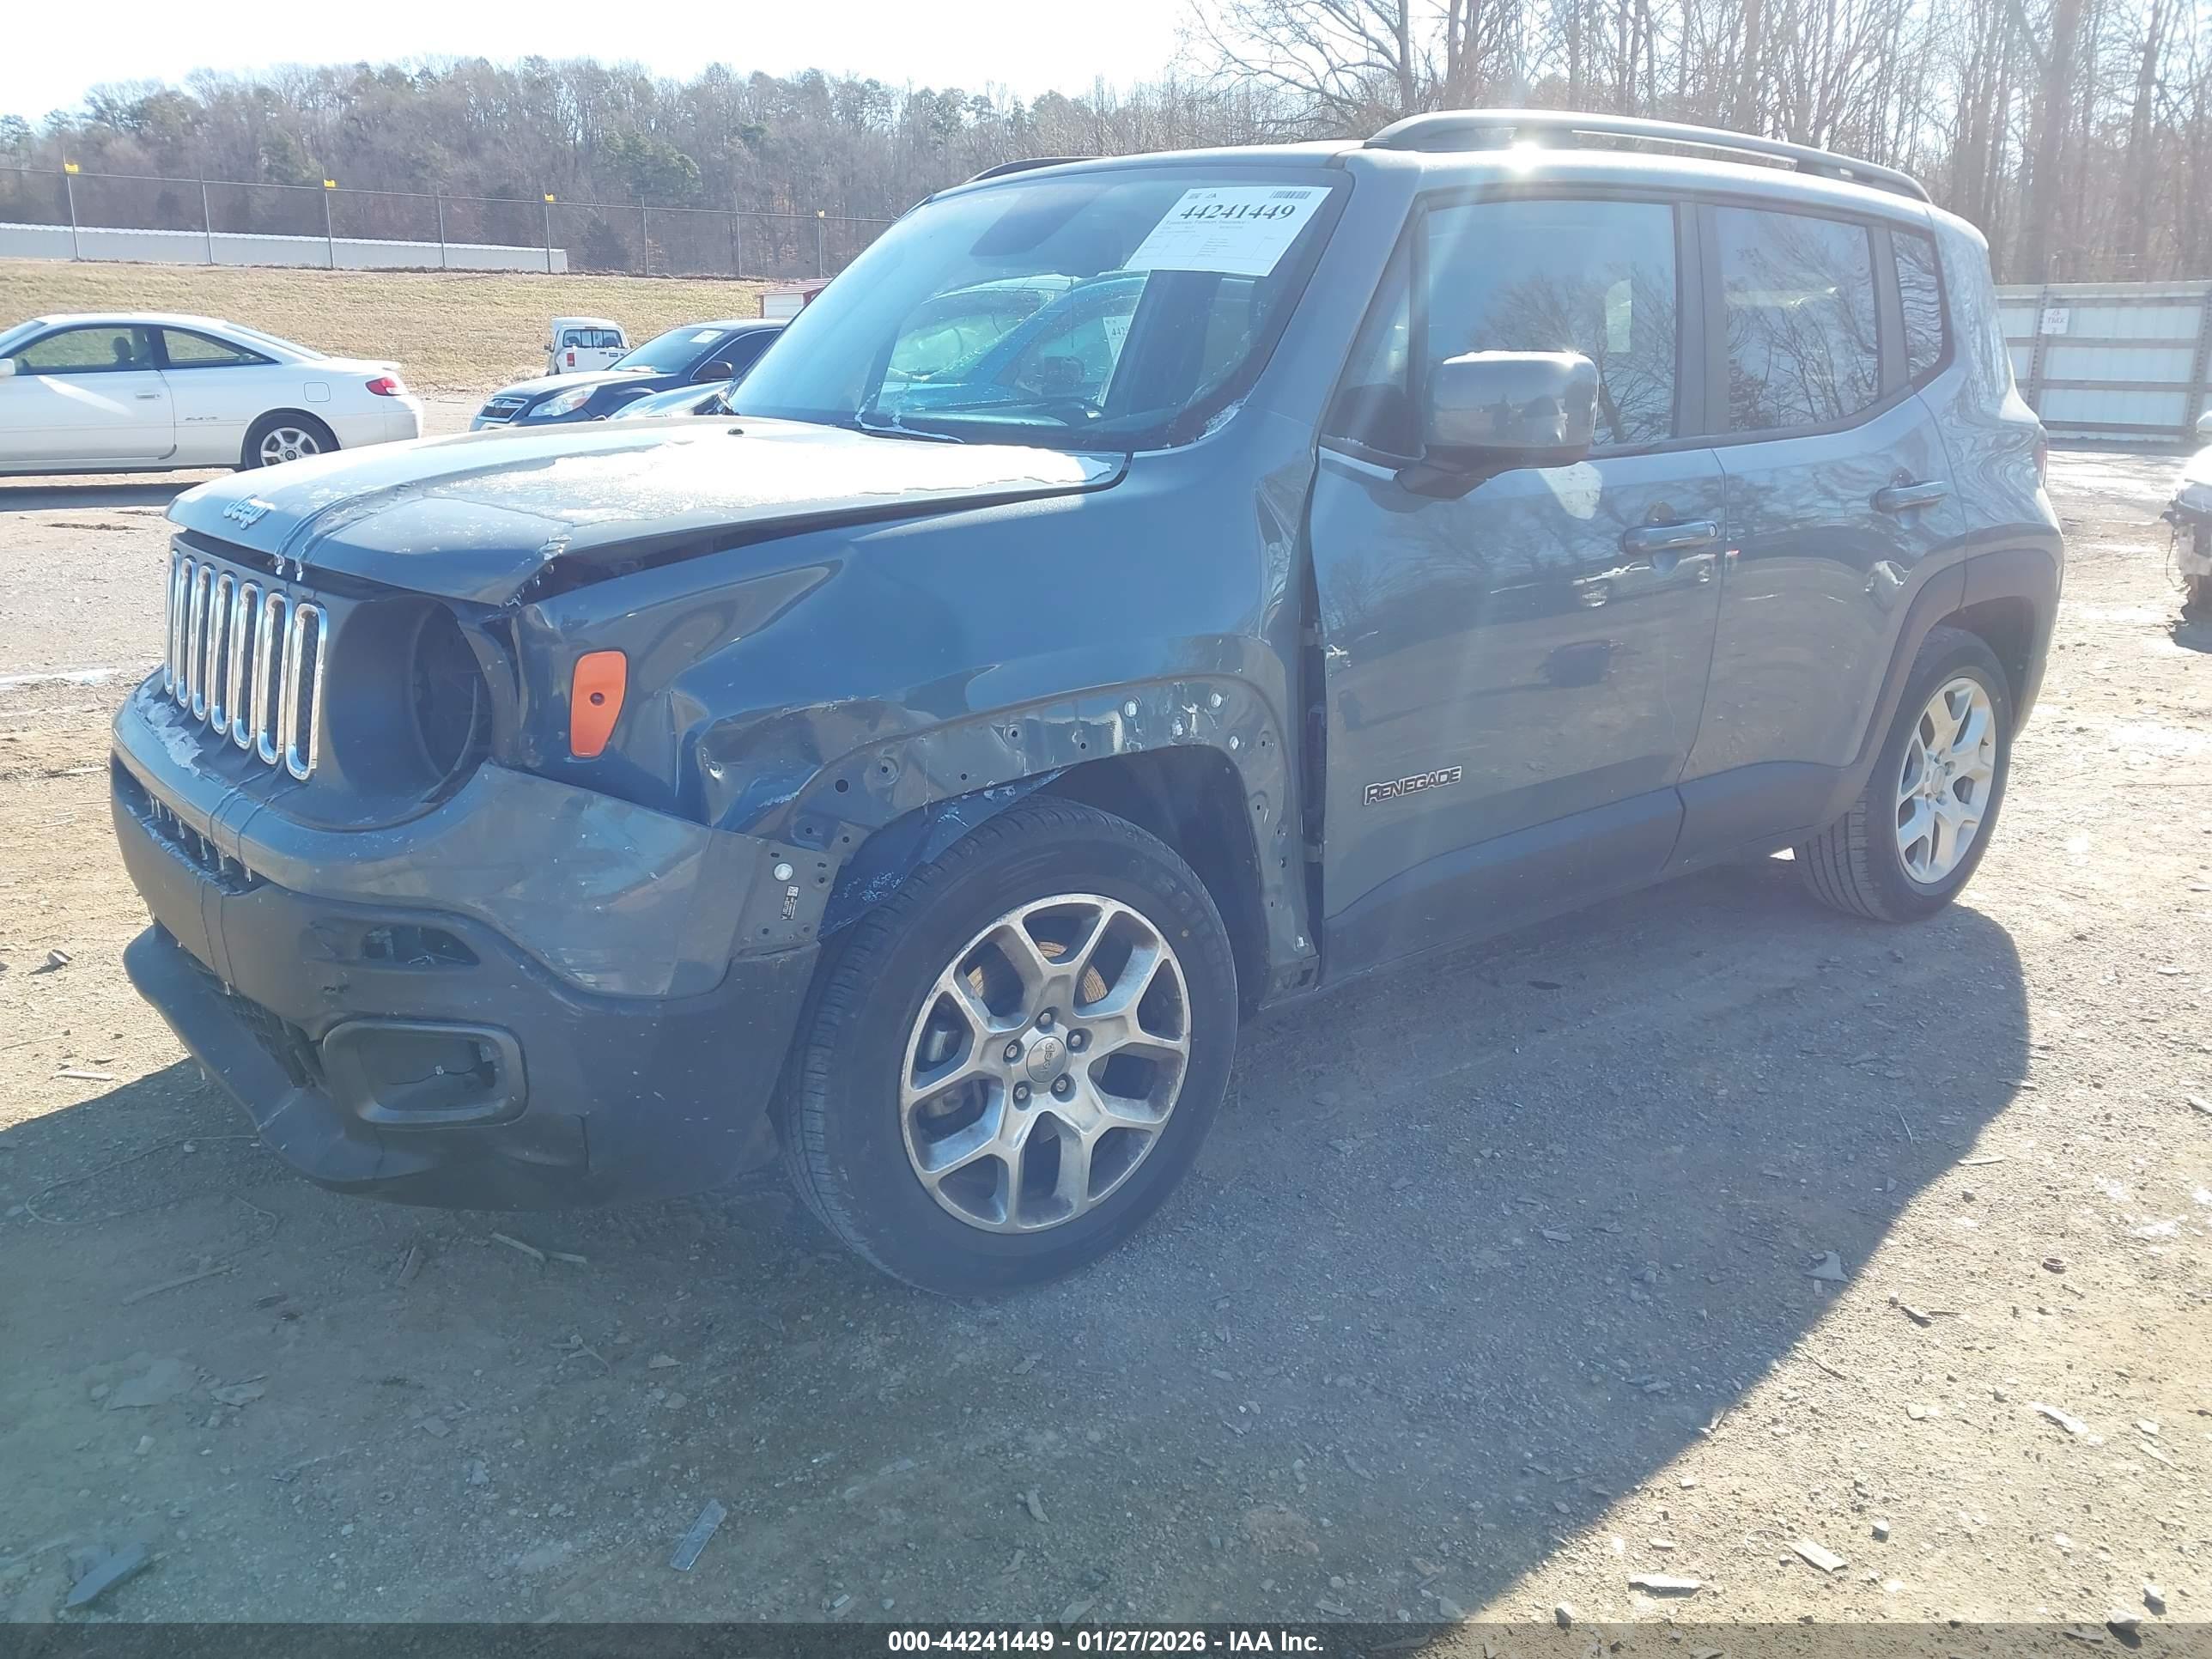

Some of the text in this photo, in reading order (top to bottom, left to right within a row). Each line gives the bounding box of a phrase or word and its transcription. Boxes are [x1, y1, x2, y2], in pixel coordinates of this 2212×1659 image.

[1180, 204, 1296, 220] 44241449
[223, 494, 274, 530] Jeep
[1364, 765, 1462, 805] RENEGADE
[1040, 1042, 1055, 1073] Jeep
